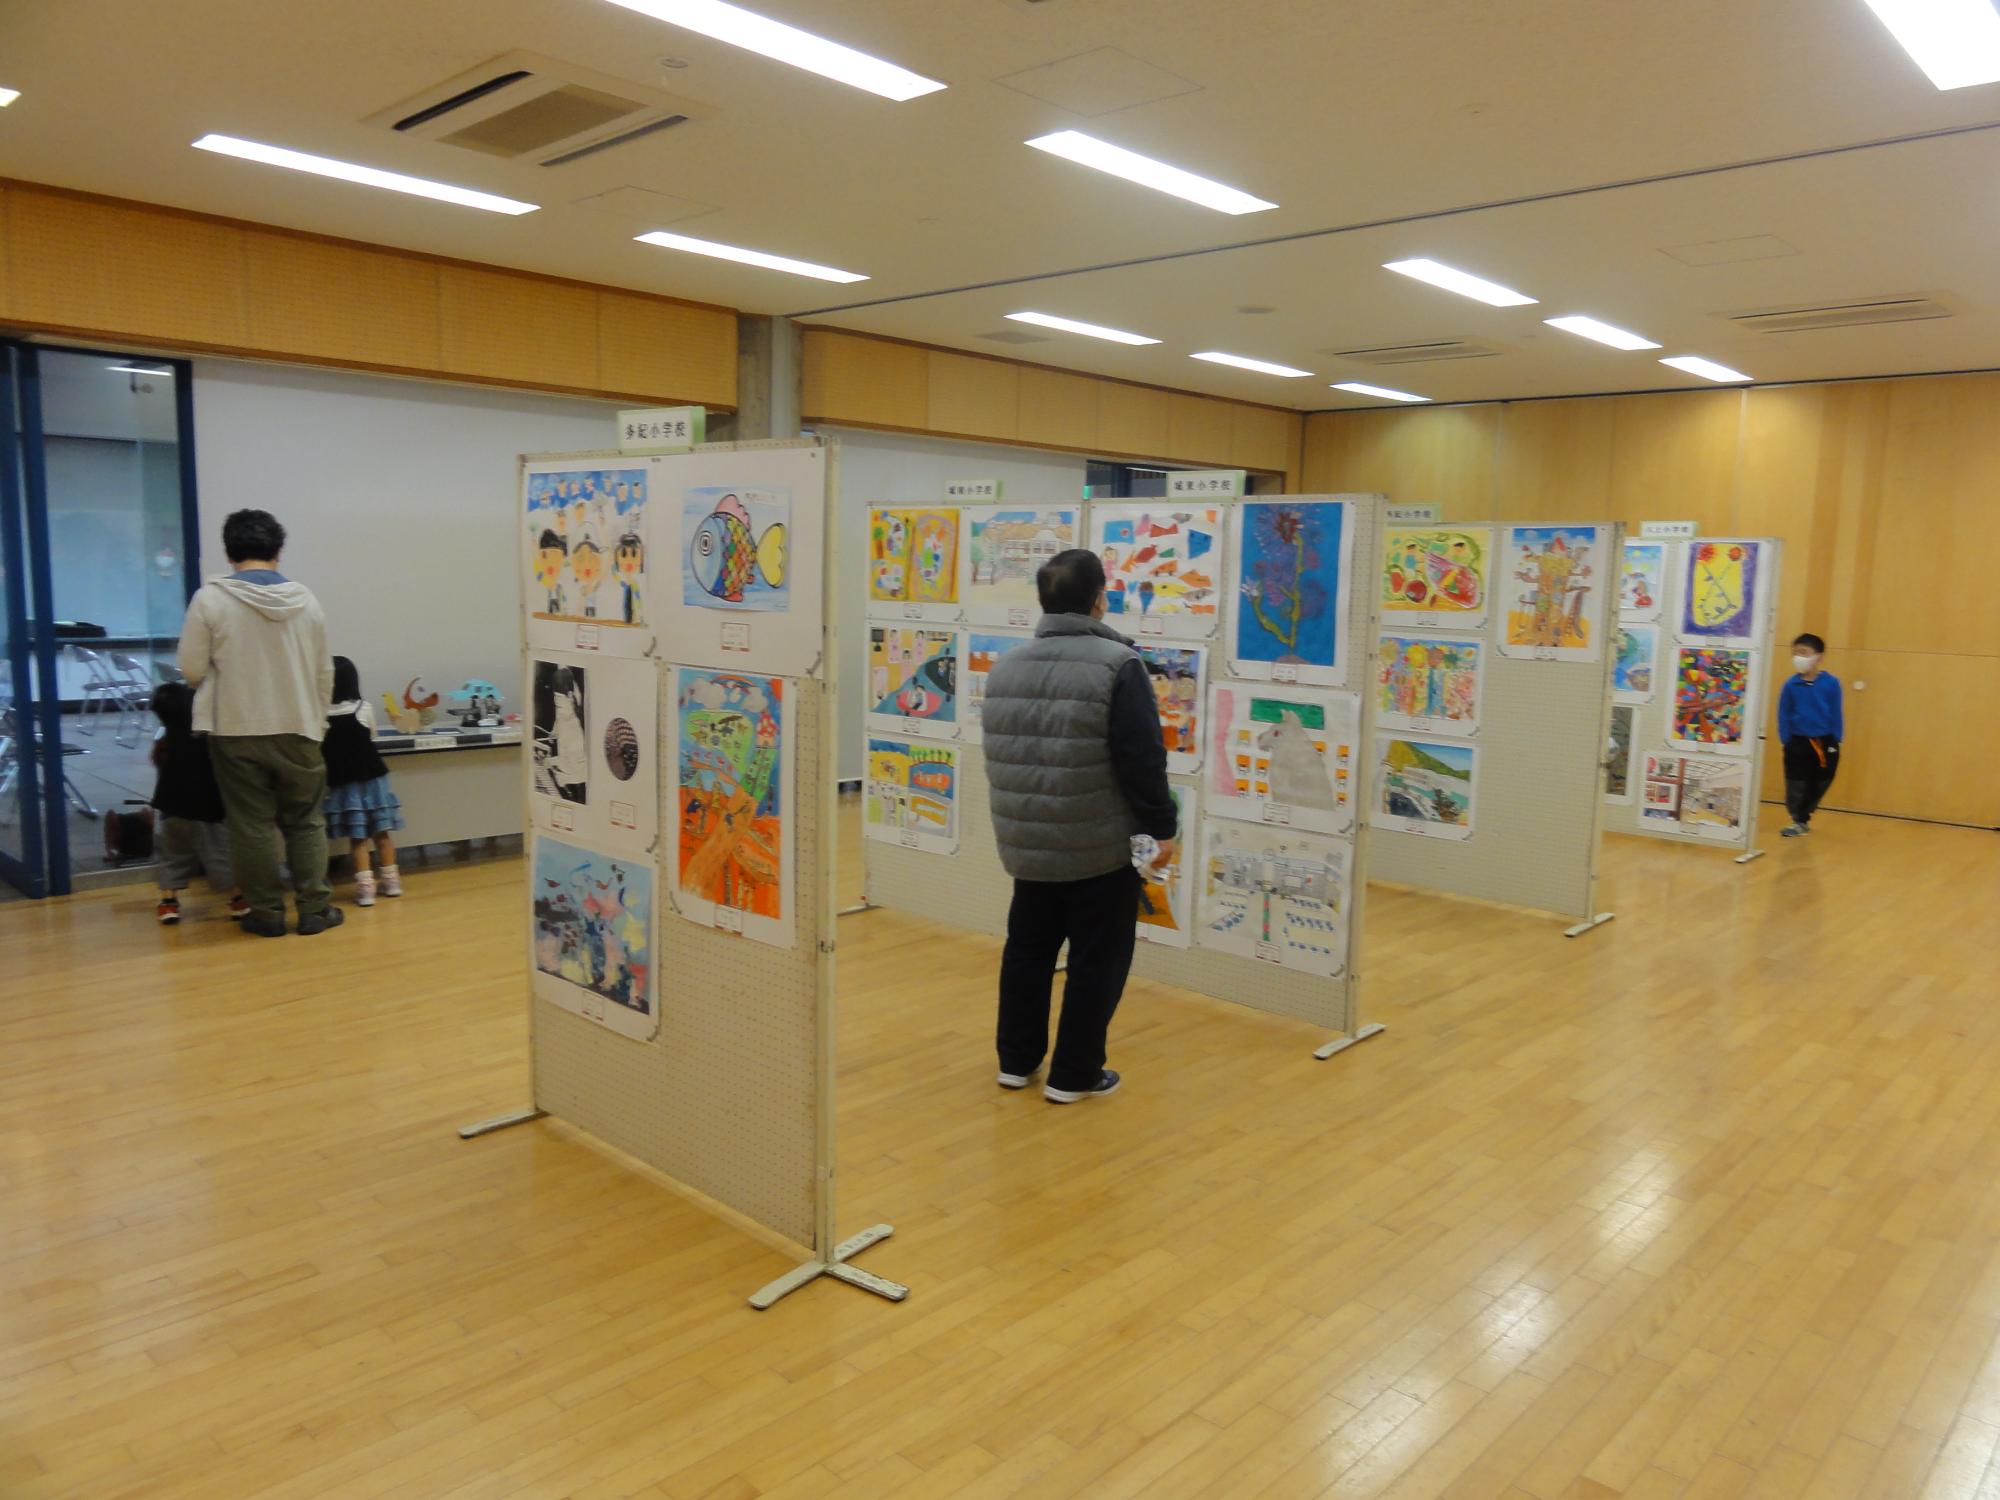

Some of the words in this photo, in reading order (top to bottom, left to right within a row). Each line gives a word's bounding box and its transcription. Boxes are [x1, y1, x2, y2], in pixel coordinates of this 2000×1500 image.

[624, 421, 686, 440] 多紀小学校
